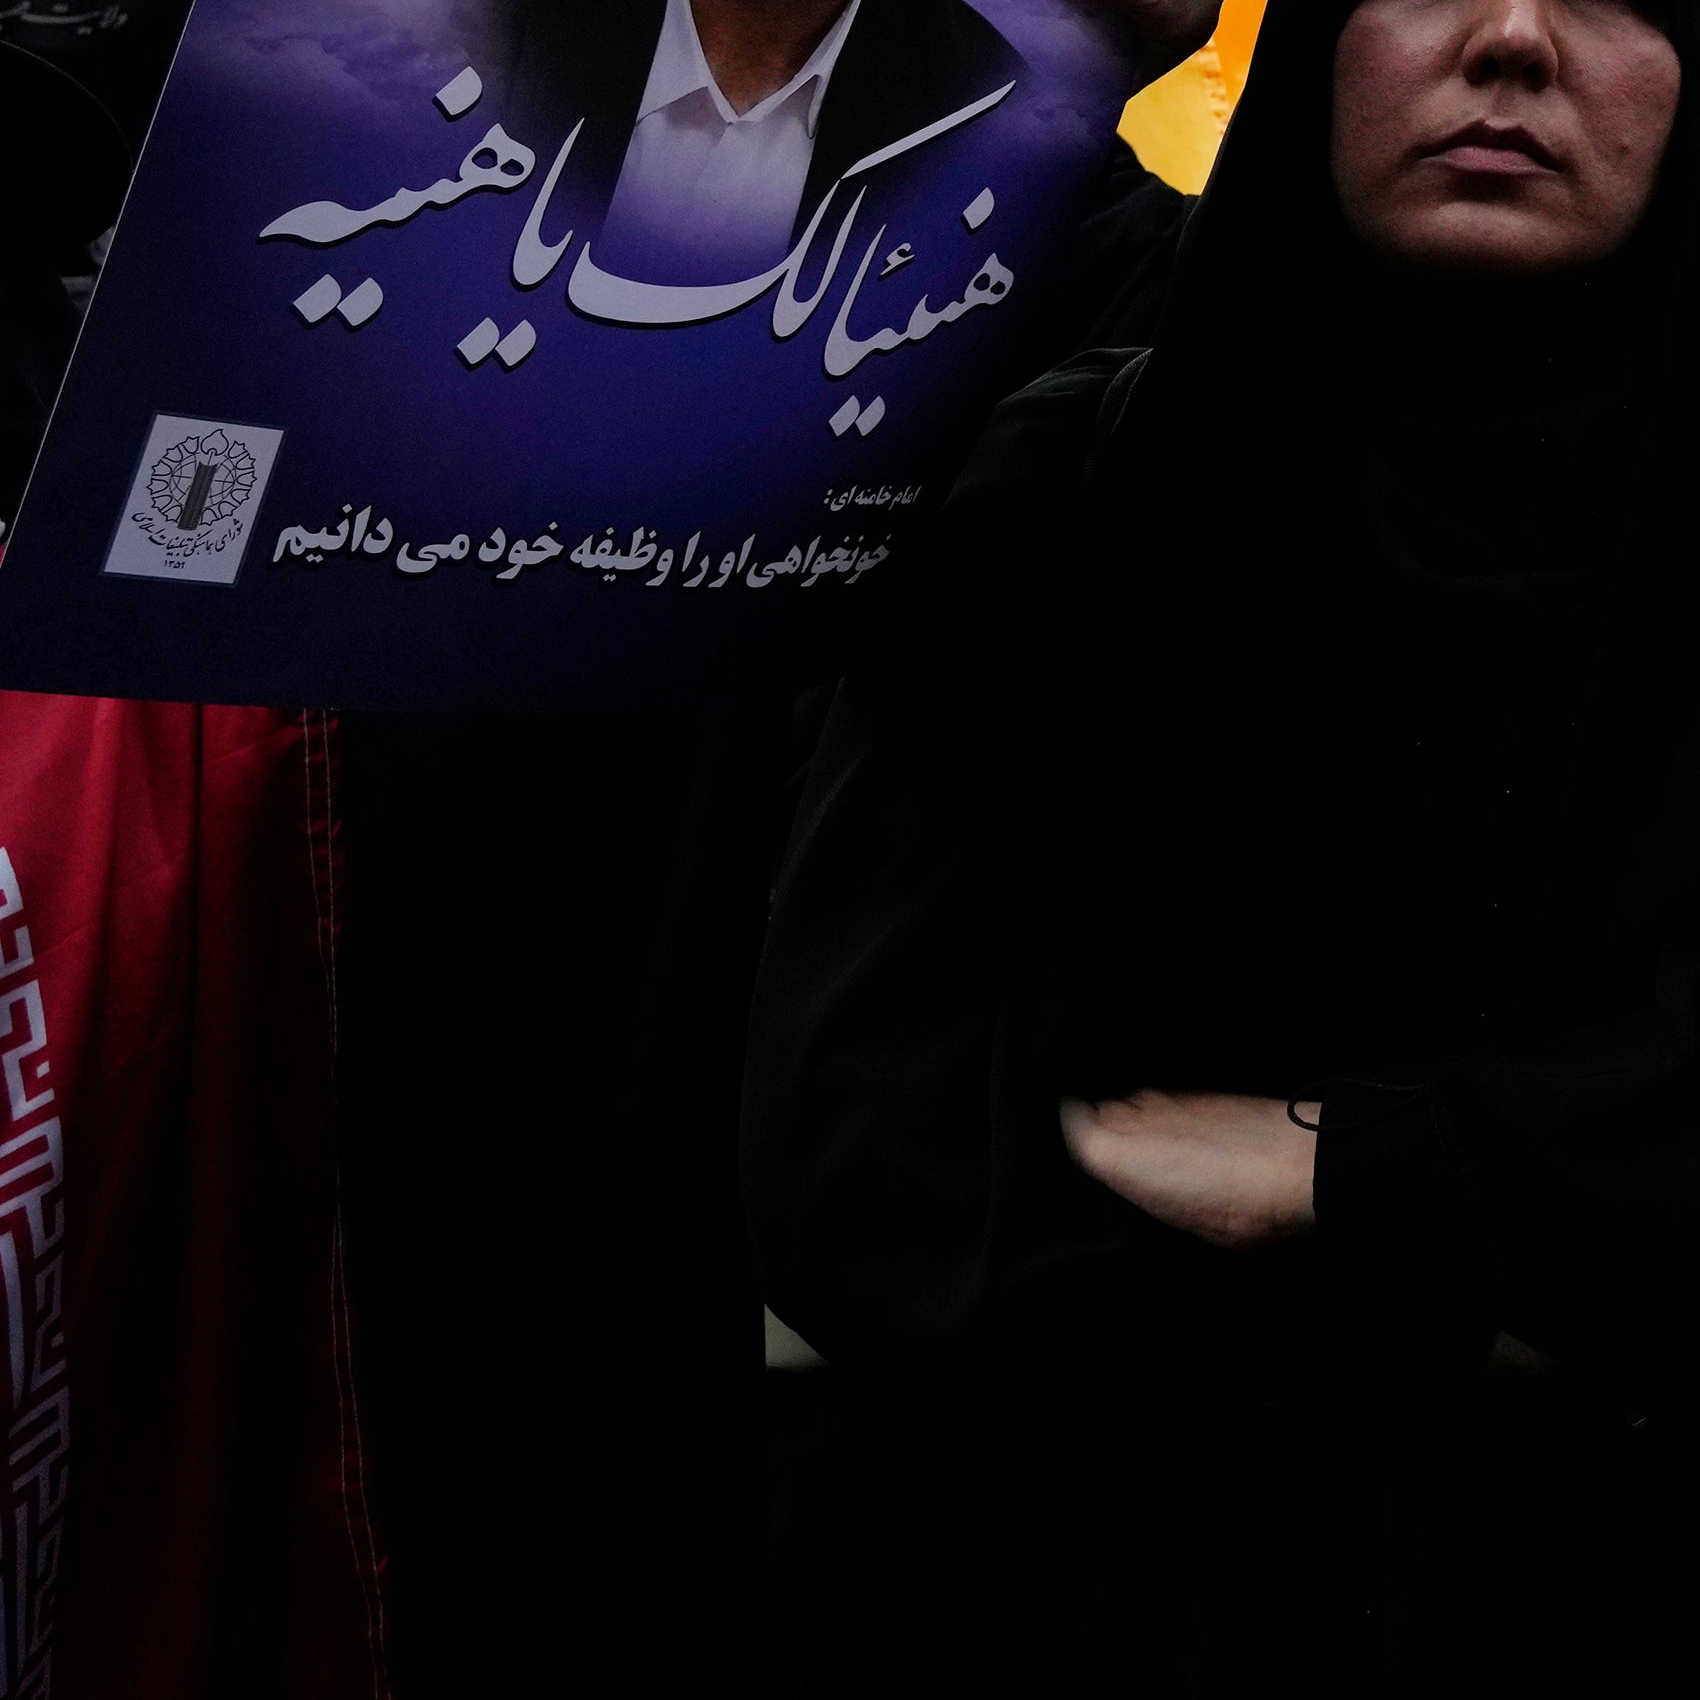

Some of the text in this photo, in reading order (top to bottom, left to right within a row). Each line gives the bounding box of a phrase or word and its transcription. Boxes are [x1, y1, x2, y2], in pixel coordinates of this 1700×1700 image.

[457, 116, 587, 367] یا
[272, 503, 891, 588] خونخواهی او را وظیفه خود می دانیم
